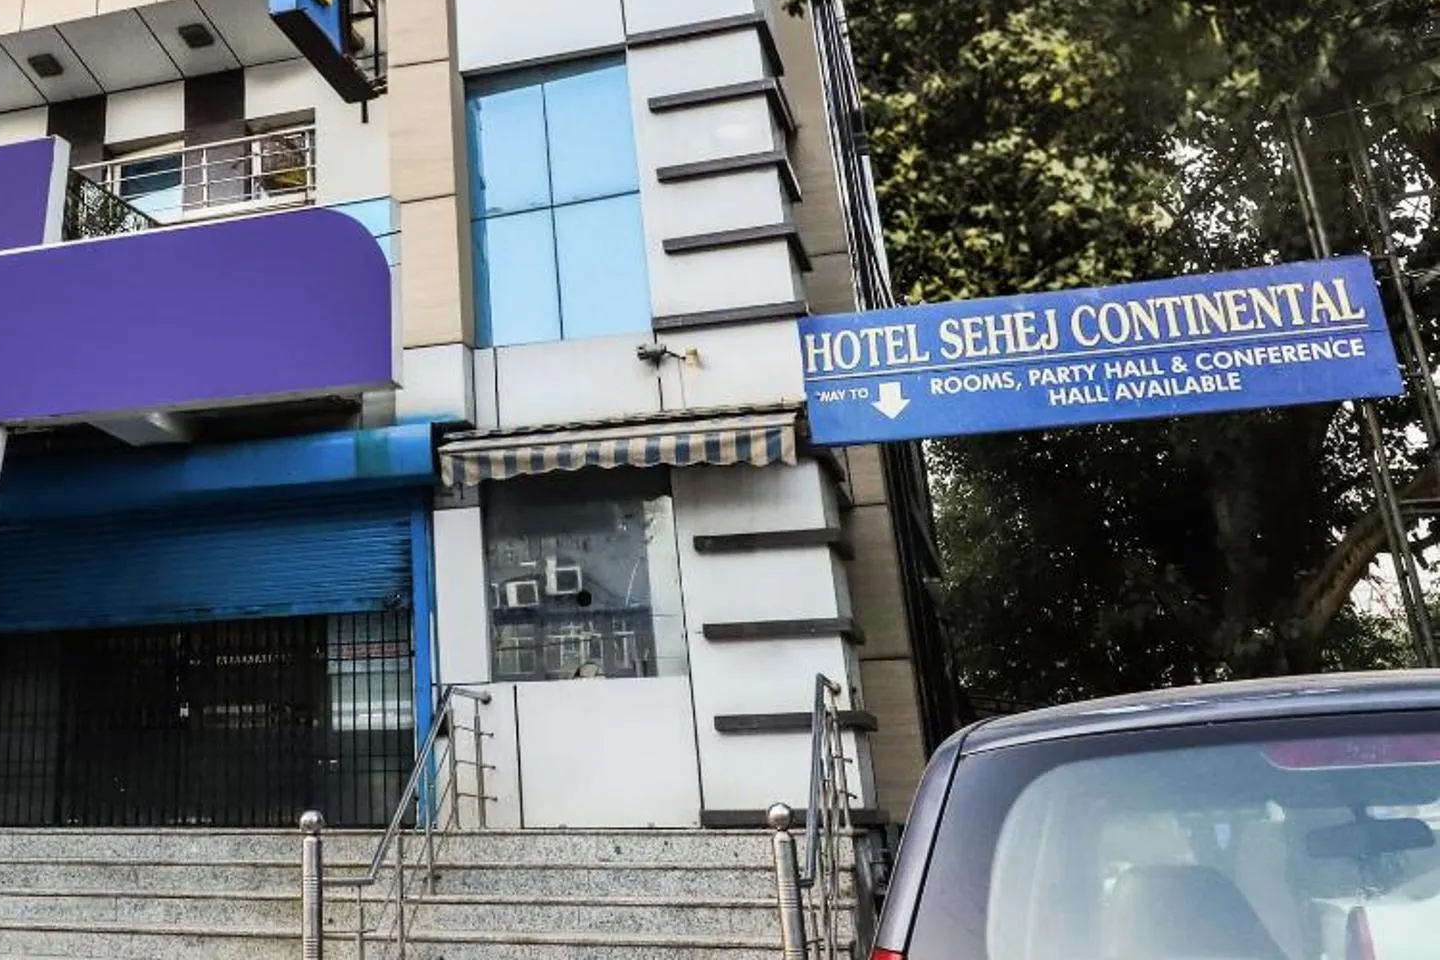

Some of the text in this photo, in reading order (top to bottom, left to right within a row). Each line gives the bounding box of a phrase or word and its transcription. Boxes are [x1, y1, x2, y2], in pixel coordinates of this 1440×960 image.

[805, 278, 1365, 373] HOTEL SEHEJ CONTINENTAL
[930, 338, 1366, 395] ROOMS, PARTY HALL & CONFERENCE
[1049, 371, 1242, 407] HALL AVAILABLE
[850, 387, 869, 399] TO
